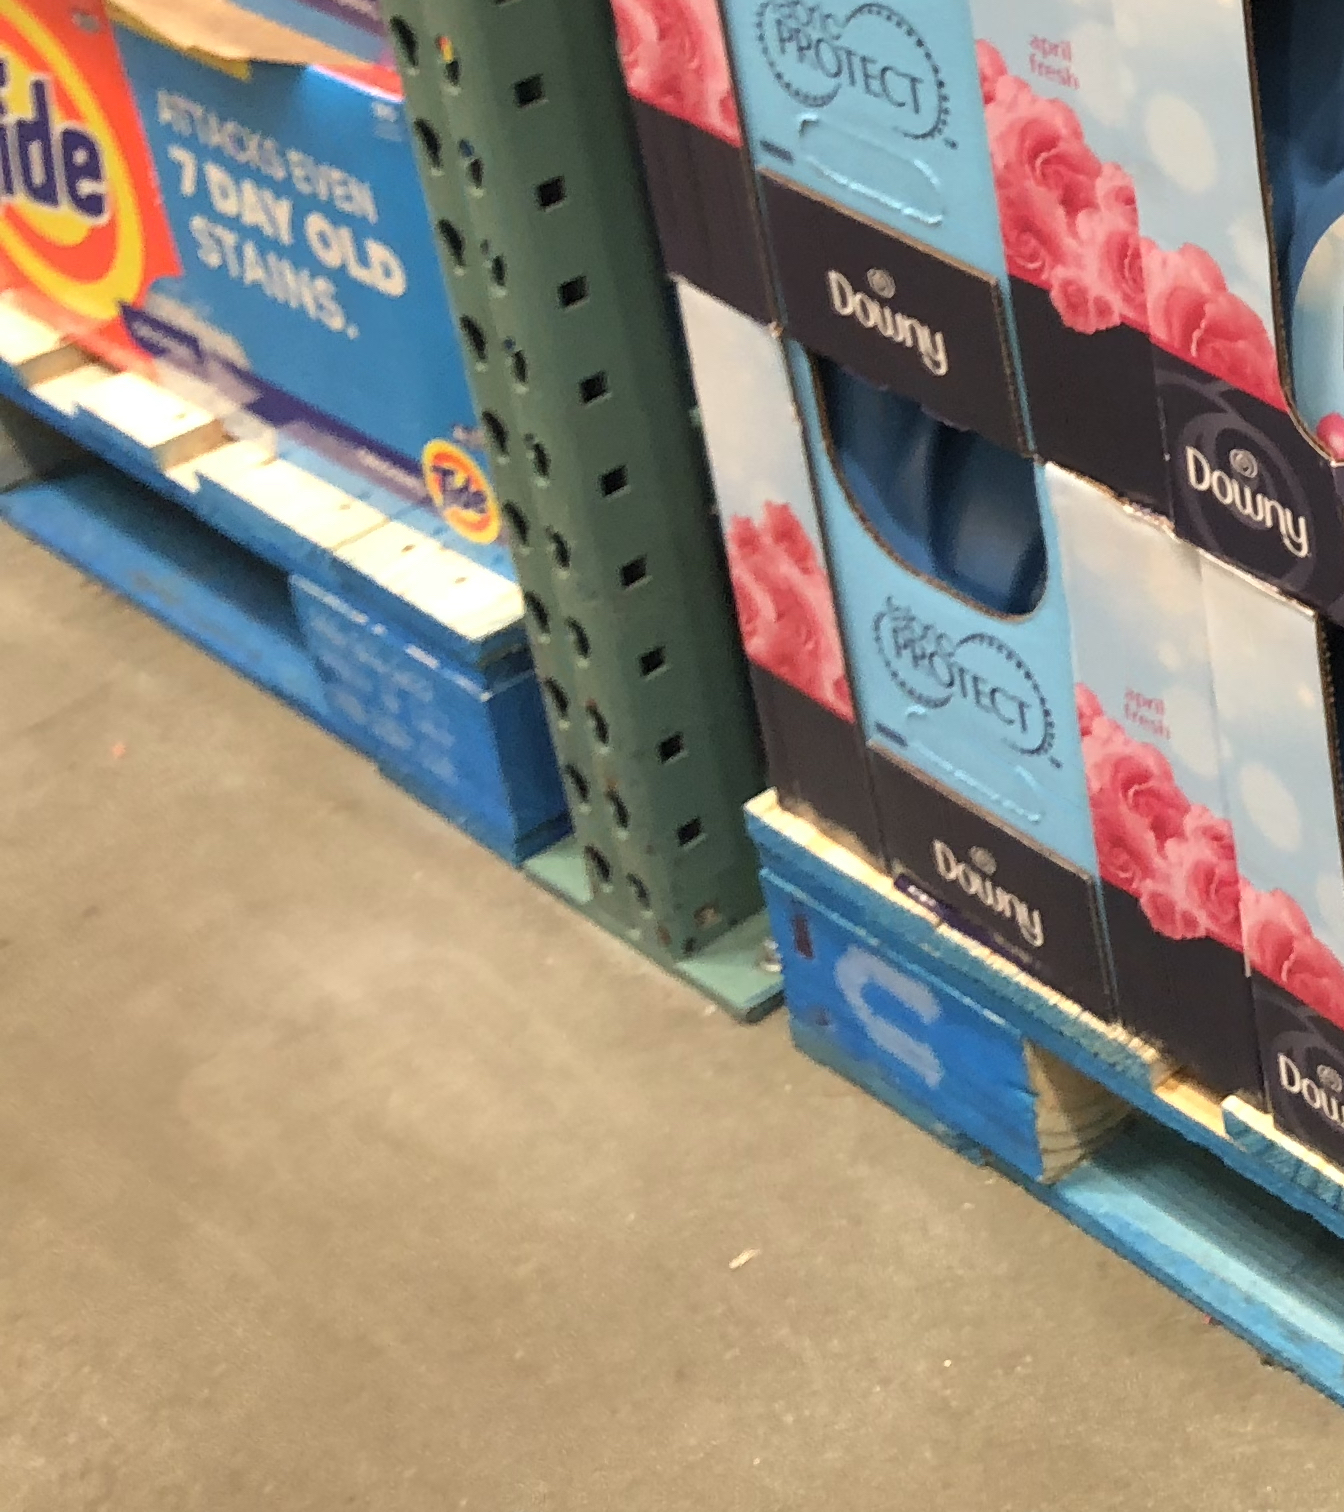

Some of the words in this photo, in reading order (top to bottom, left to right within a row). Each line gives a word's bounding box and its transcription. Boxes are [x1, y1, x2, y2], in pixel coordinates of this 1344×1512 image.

[167, 143, 198, 198] 7
[203, 160, 294, 247] DAY
[304, 210, 407, 298] OLD
[824, 268, 949, 377] Downy
[1185, 445, 1311, 559] Downy
[931, 838, 1047, 948] Downy
